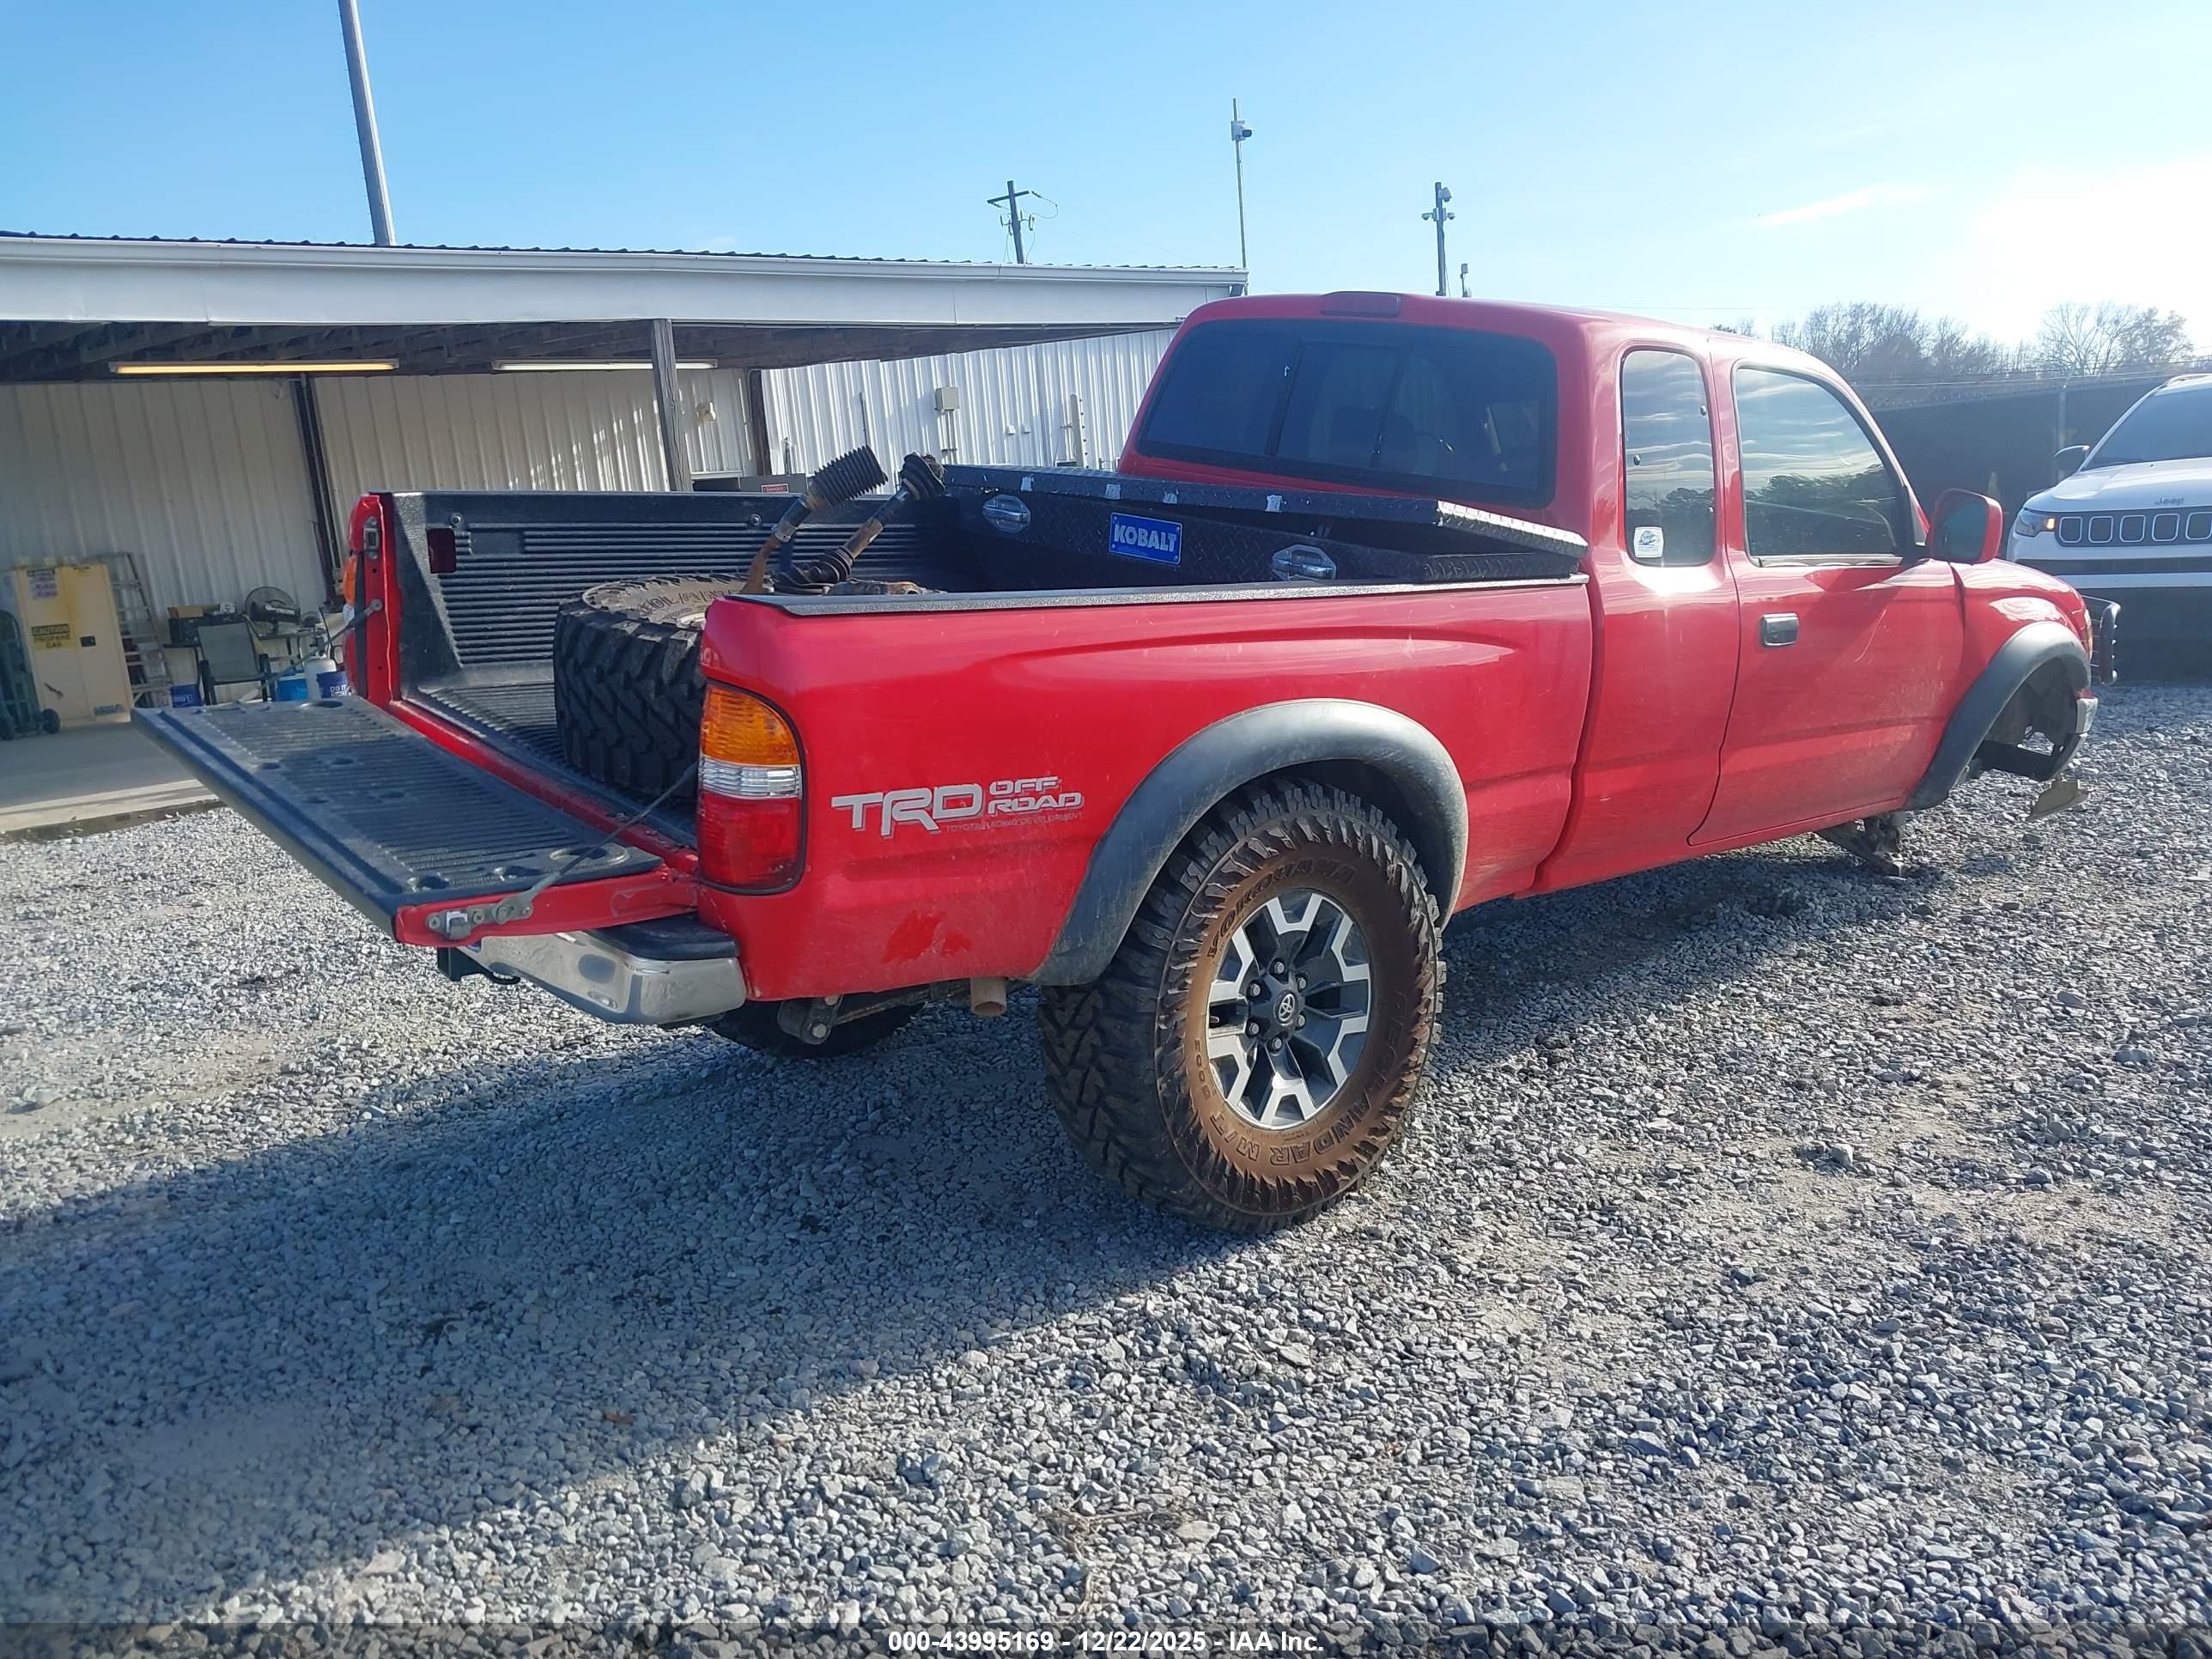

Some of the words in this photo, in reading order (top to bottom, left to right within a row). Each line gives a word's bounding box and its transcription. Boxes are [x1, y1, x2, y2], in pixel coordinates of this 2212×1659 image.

[2154, 496, 2185, 506] Jeep
[1114, 522, 1177, 552] KOBALT
[988, 775, 1060, 797] OFF
[830, 782, 984, 838] TRD
[988, 792, 1085, 815] ROAD
